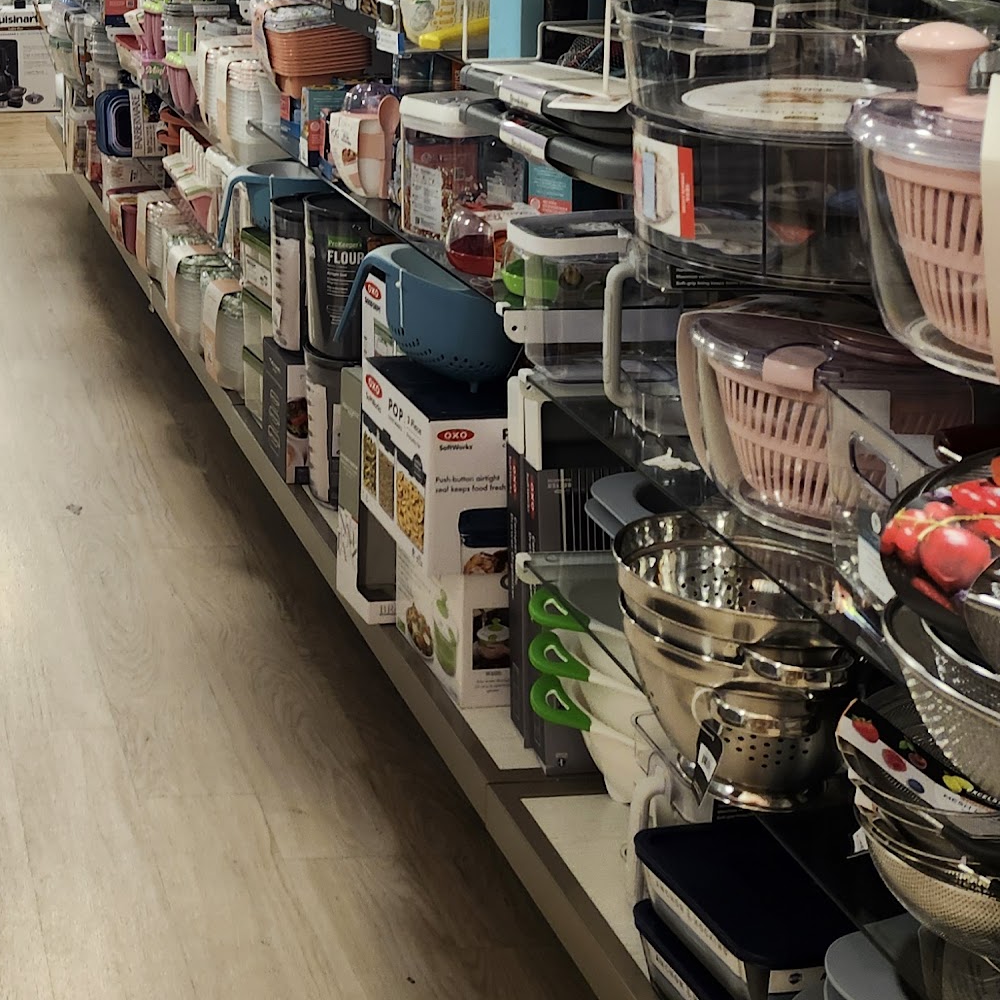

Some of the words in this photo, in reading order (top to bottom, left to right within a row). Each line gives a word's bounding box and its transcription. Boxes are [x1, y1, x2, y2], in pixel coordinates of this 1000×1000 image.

[388, 398, 404, 420] POP
[443, 431, 468, 440] OXO
[450, 486, 470, 494] keeps
[471, 484, 488, 492] food
